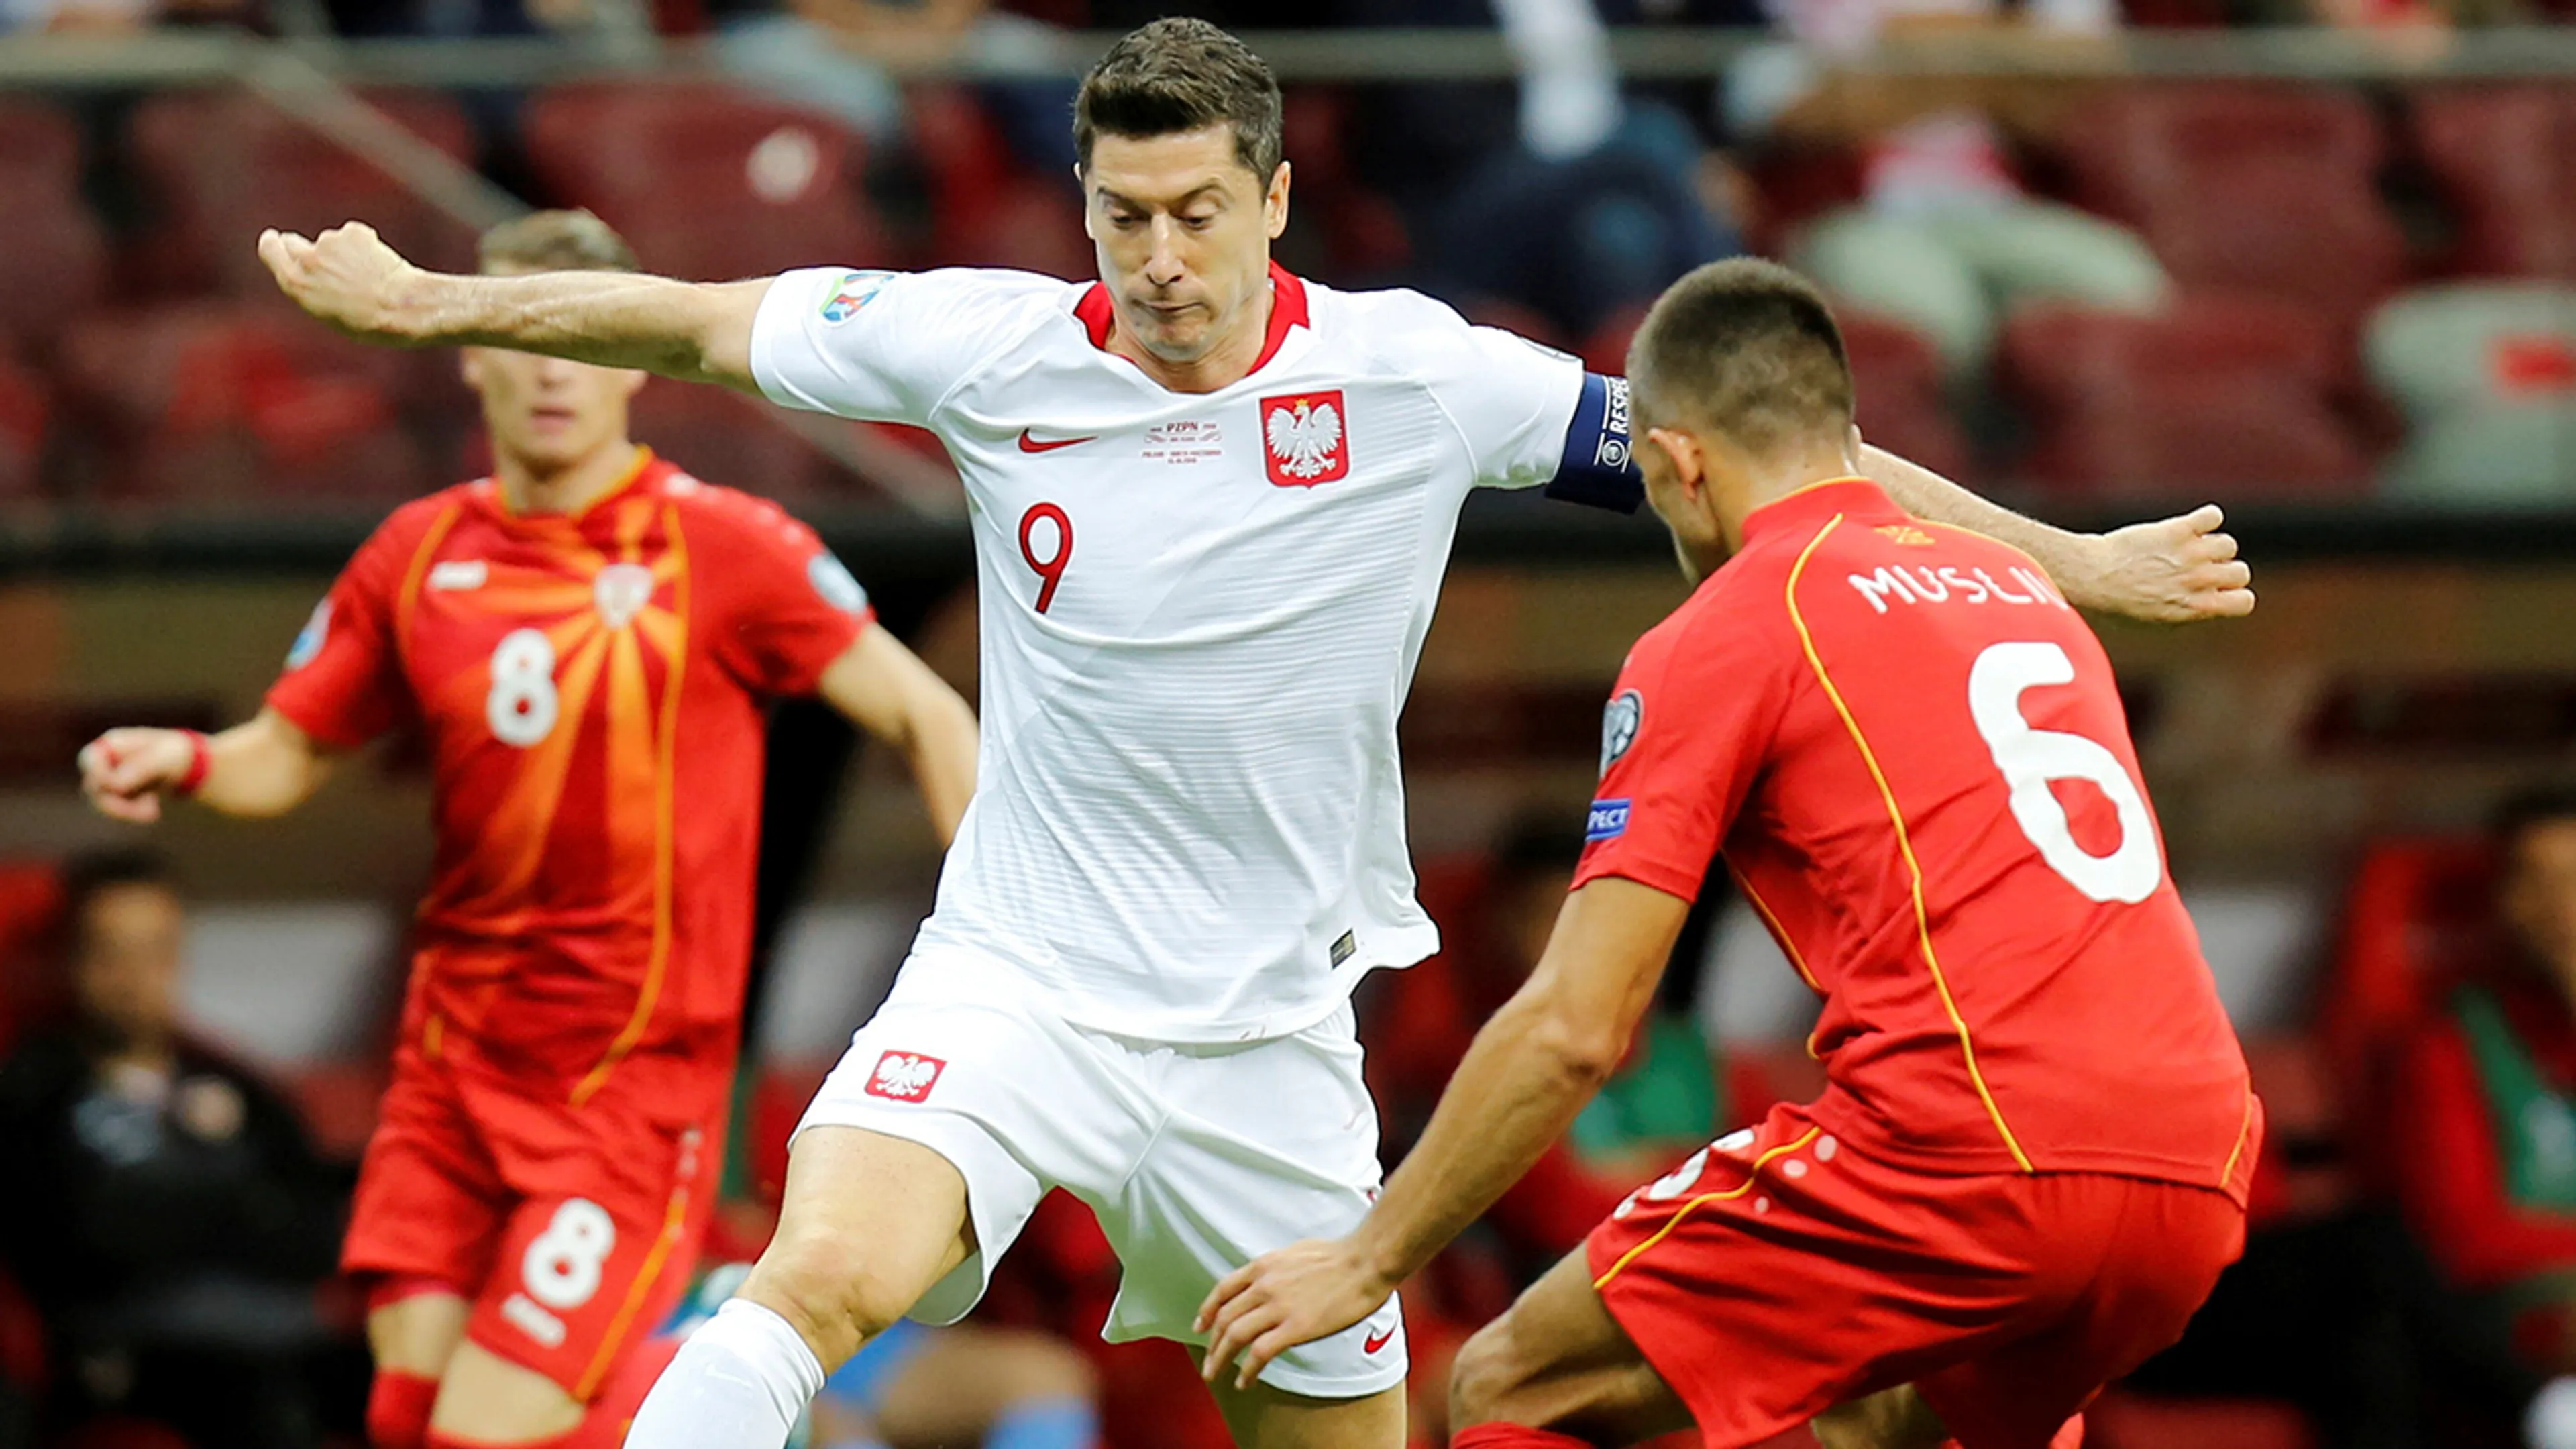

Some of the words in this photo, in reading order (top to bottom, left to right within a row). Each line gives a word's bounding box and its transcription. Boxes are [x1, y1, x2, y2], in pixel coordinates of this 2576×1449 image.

[1018, 502, 1072, 614] 9
[486, 628, 559, 748] 8
[1968, 642, 2161, 904] 6
[521, 1197, 616, 1311] 8
